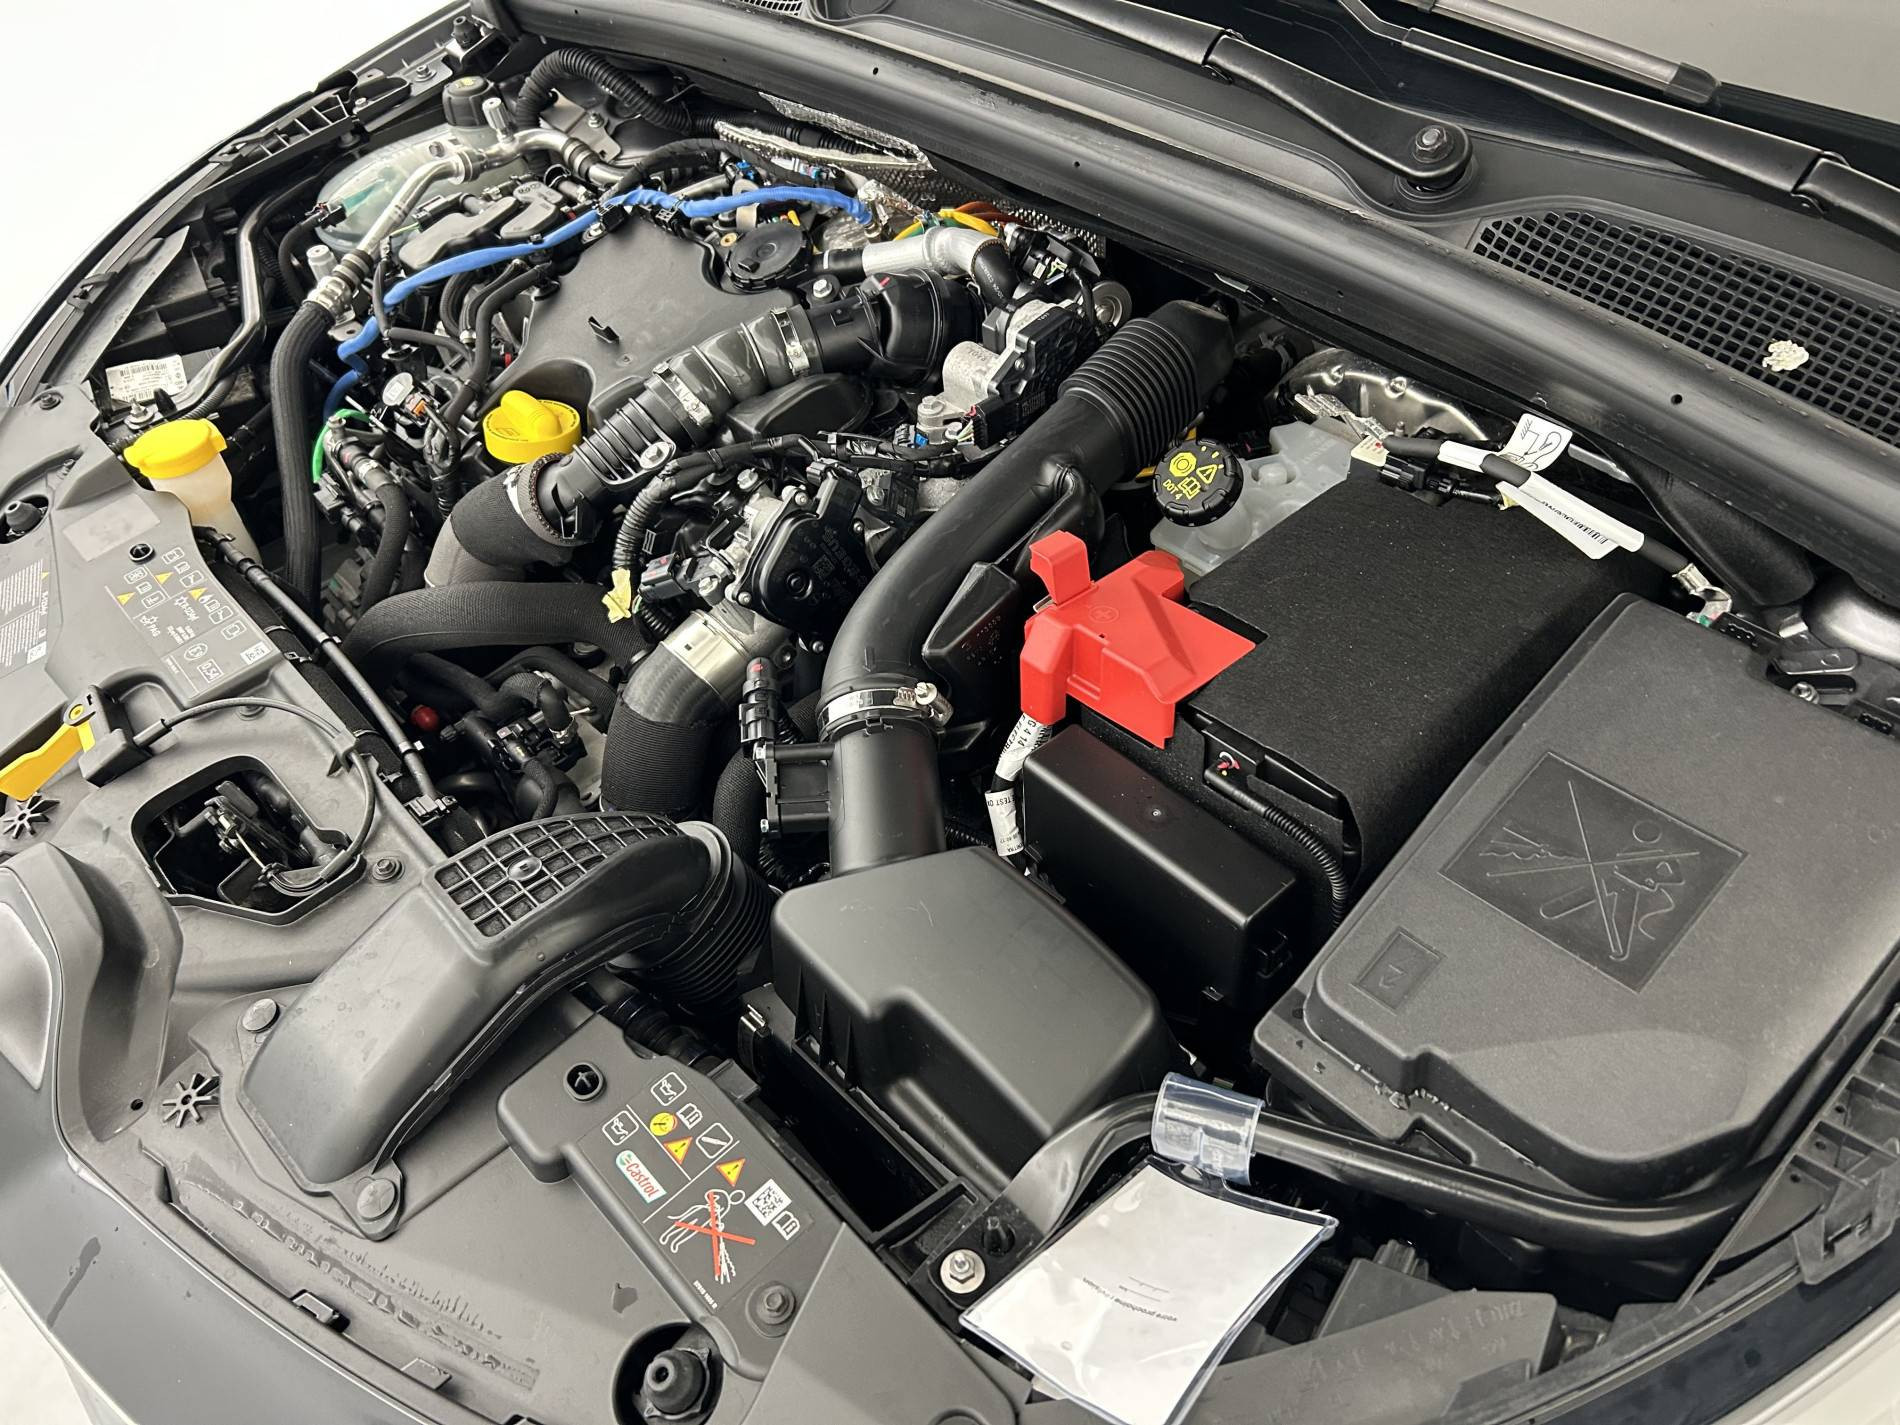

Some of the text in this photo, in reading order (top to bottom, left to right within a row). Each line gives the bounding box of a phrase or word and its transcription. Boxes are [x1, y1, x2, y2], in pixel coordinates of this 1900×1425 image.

[1162, 479, 1183, 501] DOT 4
[1027, 719, 1037, 728] G
[996, 797, 1012, 806] TEST
[626, 1163, 660, 1198] Castrol
